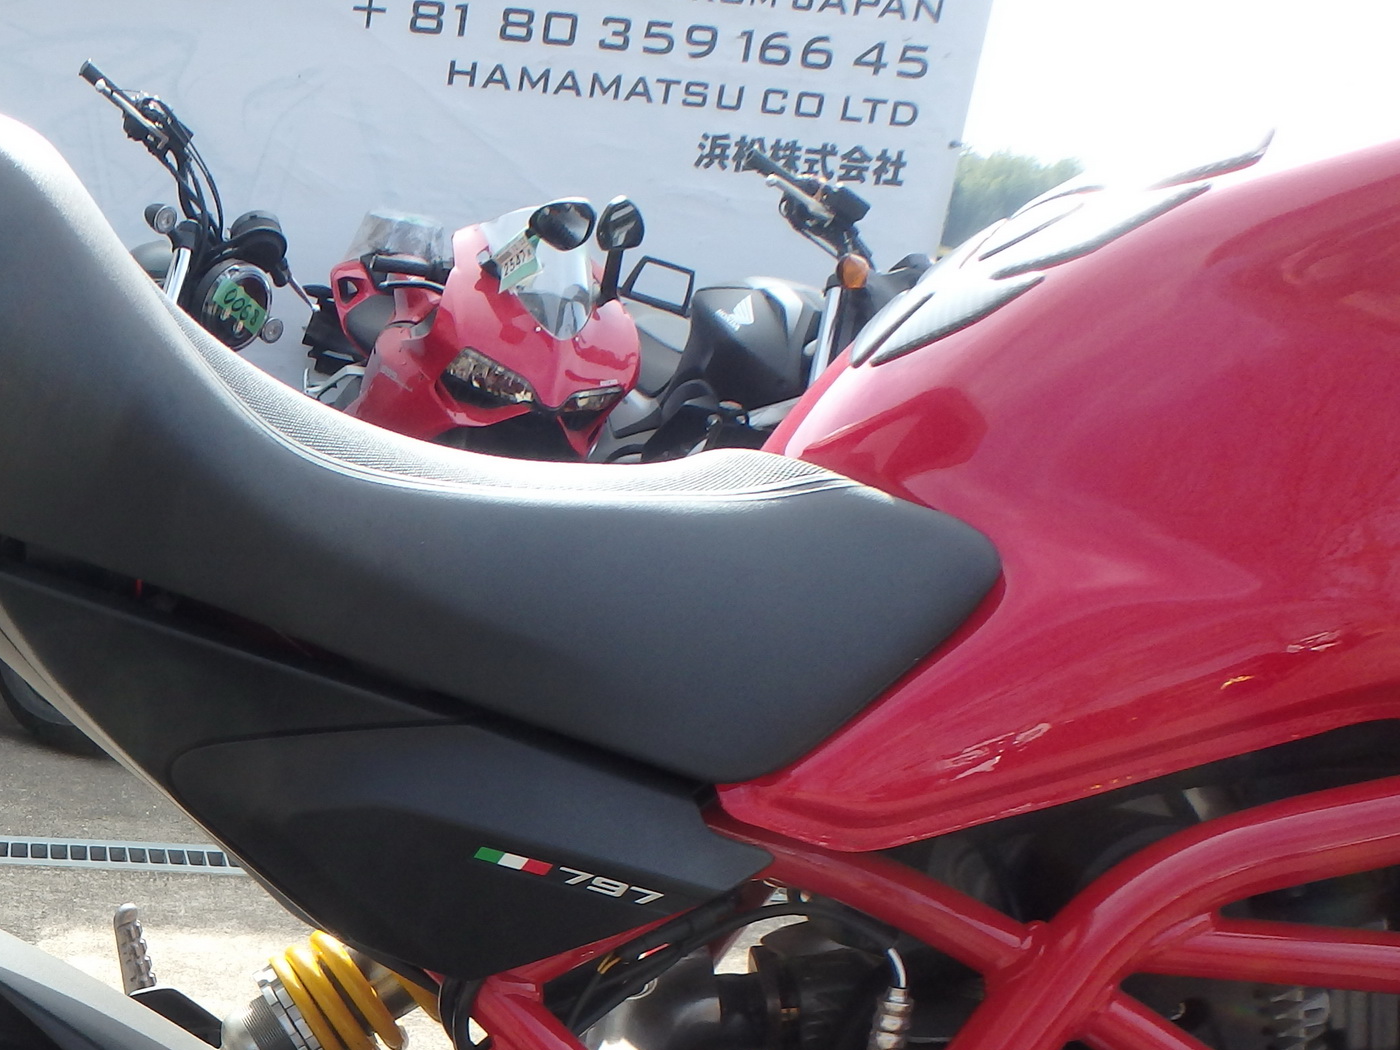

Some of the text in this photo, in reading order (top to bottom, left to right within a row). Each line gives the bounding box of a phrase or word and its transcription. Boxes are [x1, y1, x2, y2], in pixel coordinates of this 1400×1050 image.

[409, 0, 469, 37] 81
[500, 7, 578, 46] 80
[598, 16, 719, 59] 359
[737, 29, 833, 70] 166
[853, 41, 929, 79] 45
[447, 60, 919, 127] HAMAMATSU CO LTD
[559, 866, 665, 905] 797
